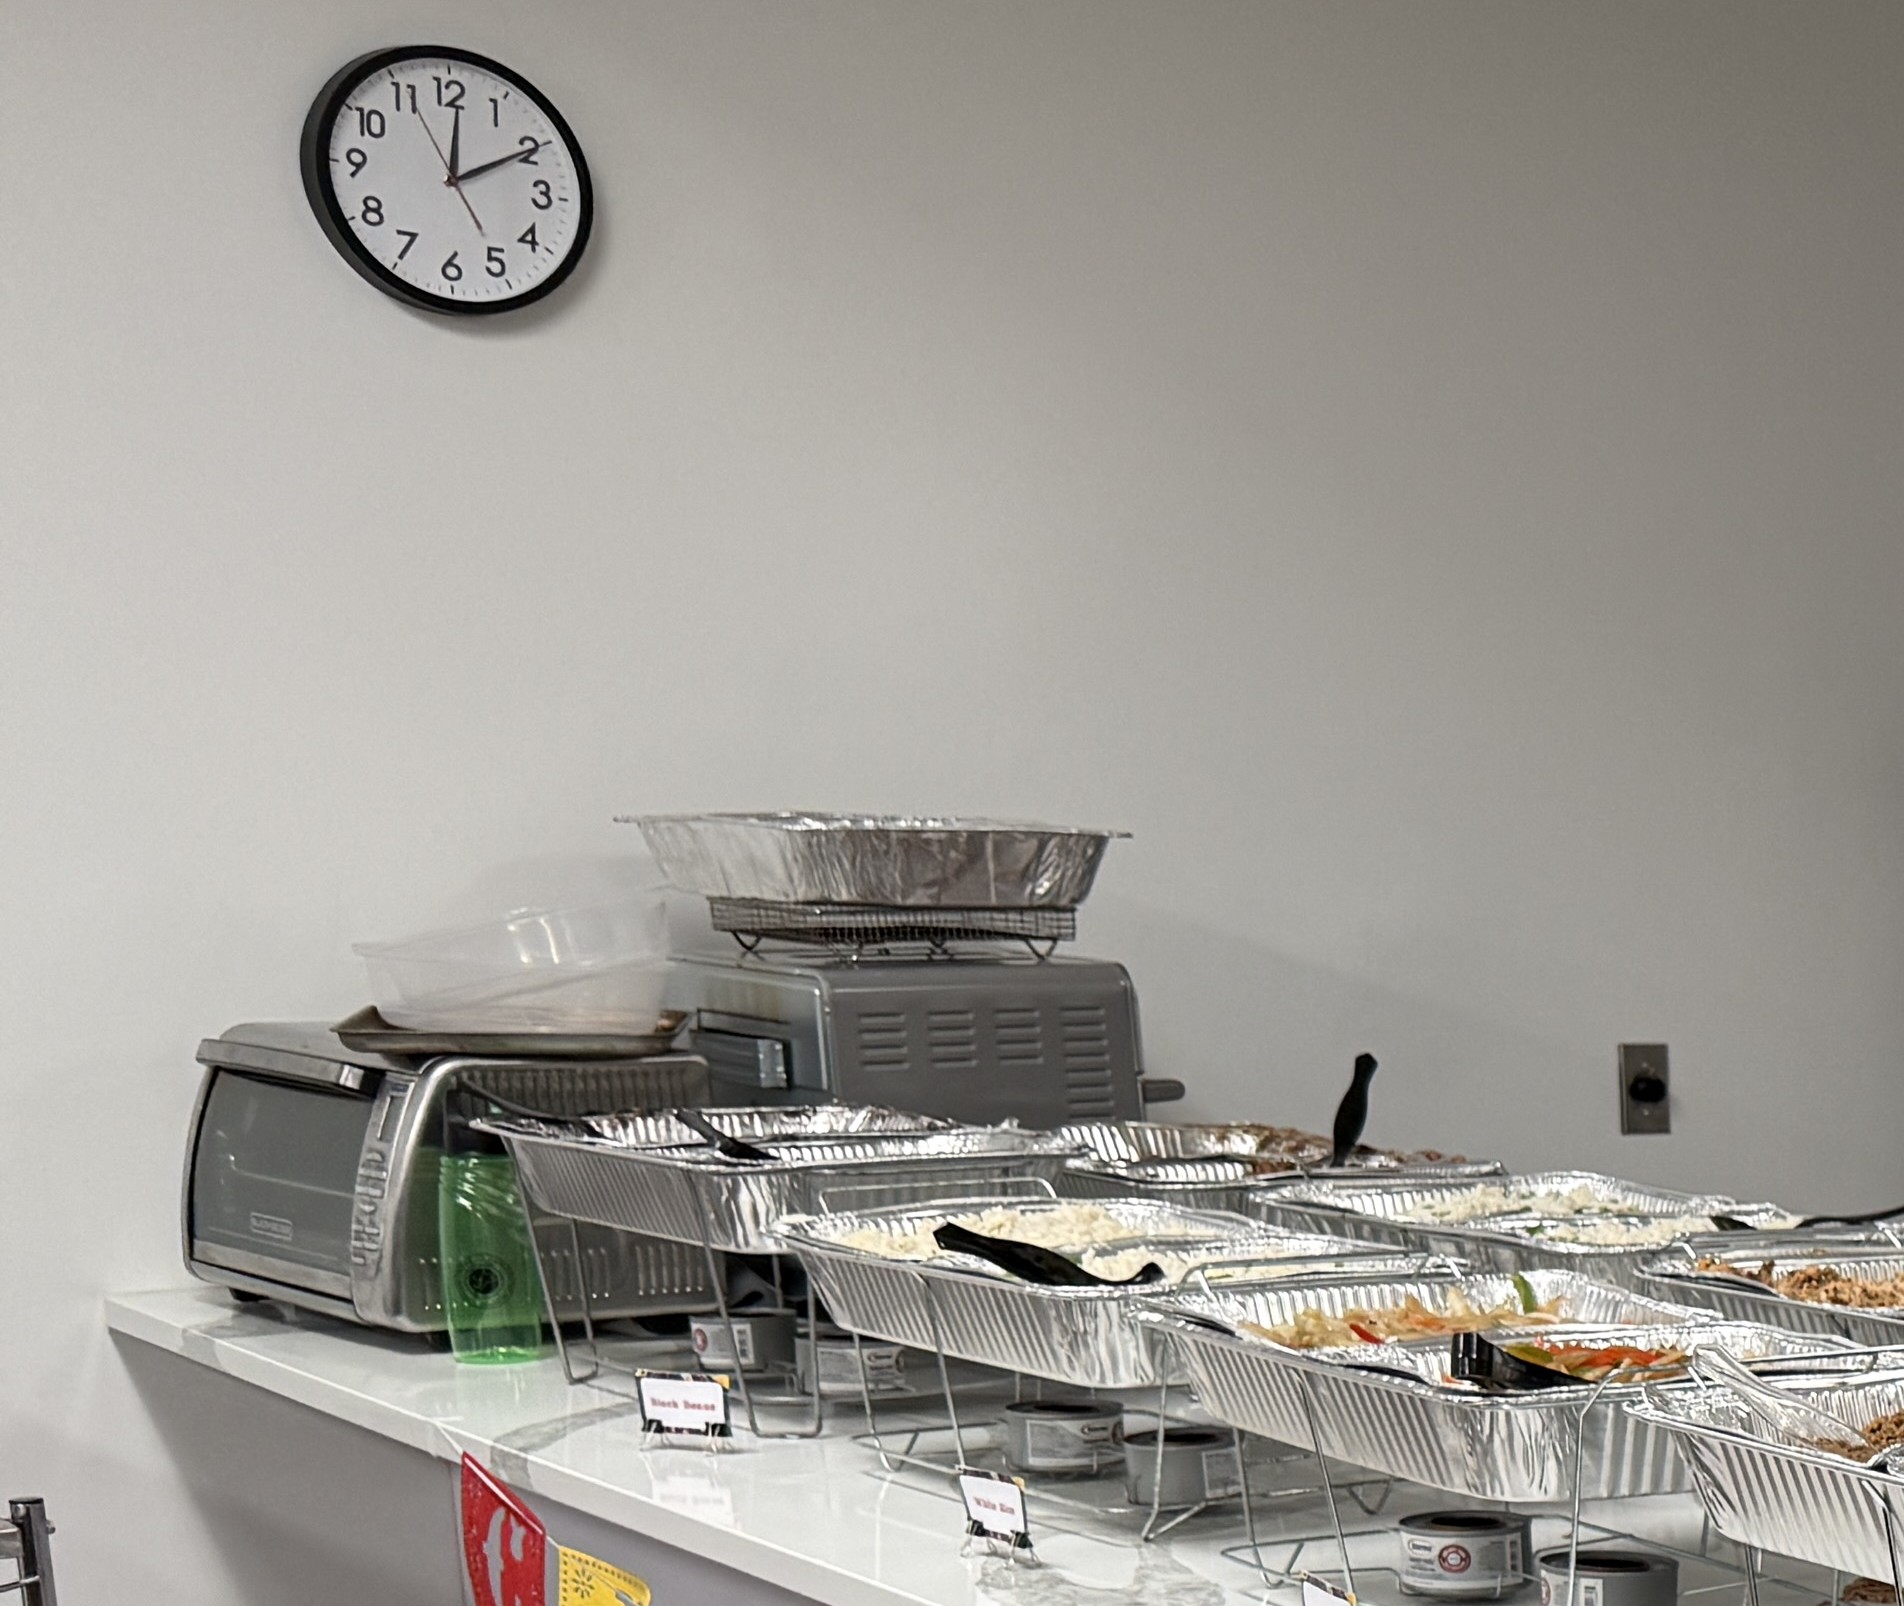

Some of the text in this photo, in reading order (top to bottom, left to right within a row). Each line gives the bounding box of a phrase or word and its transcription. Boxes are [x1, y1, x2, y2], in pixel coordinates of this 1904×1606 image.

[391, 81, 419, 114] 11
[433, 76, 467, 110] 12
[355, 106, 387, 139] 10
[489, 97, 500, 127] 1
[345, 148, 368, 178] 9
[518, 136, 540, 165] 2
[531, 180, 552, 210] 3
[361, 196, 385, 226] 8
[396, 229, 419, 260] 7
[517, 222, 540, 253] 4
[441, 251, 463, 281] 6
[486, 247, 506, 278] 5
